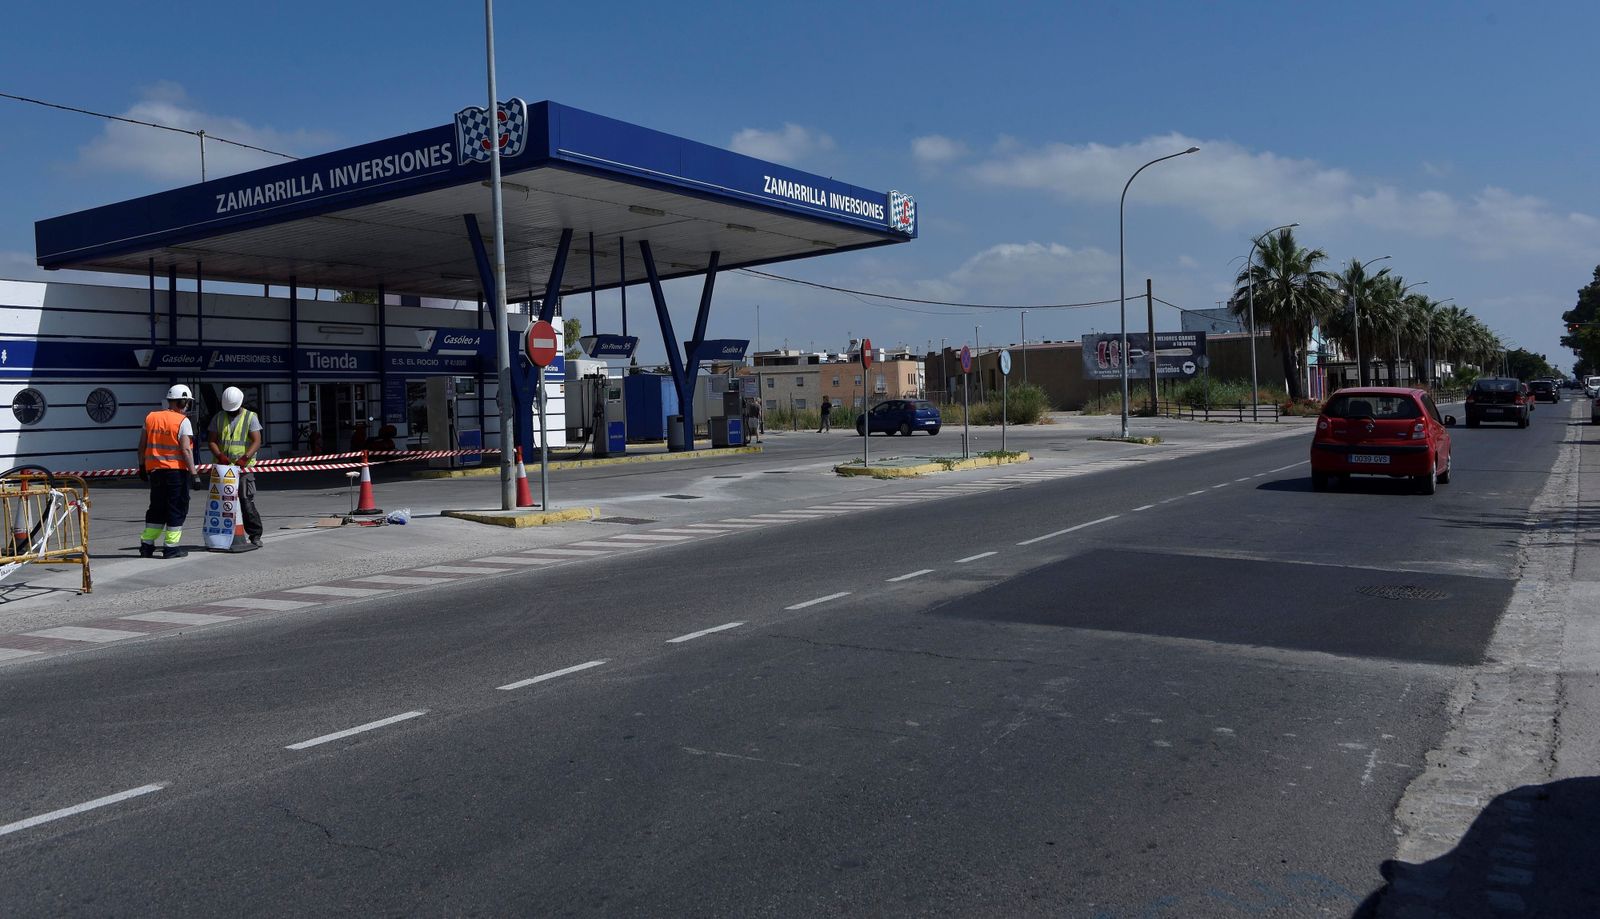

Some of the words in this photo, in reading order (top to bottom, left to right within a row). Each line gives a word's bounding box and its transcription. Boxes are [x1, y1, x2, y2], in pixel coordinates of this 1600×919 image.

[215, 172, 324, 214] ZAMARRILLA
[329, 142, 453, 189] INVERSIONES
[764, 175, 828, 207] ZAMARRILLA
[829, 192, 885, 220] INVERSIONES
[443, 334, 473, 345] Gasóleo
[474, 336, 480, 345] A
[162, 354, 195, 364] Gasóleo
[196, 355, 203, 363] A
[225, 354, 271, 363] INVERSIONES
[306, 351, 358, 369] Tienda
[407, 358, 415, 366] EL
[417, 358, 439, 366] ROCIO
[1374, 455, 1388, 463] GVS
